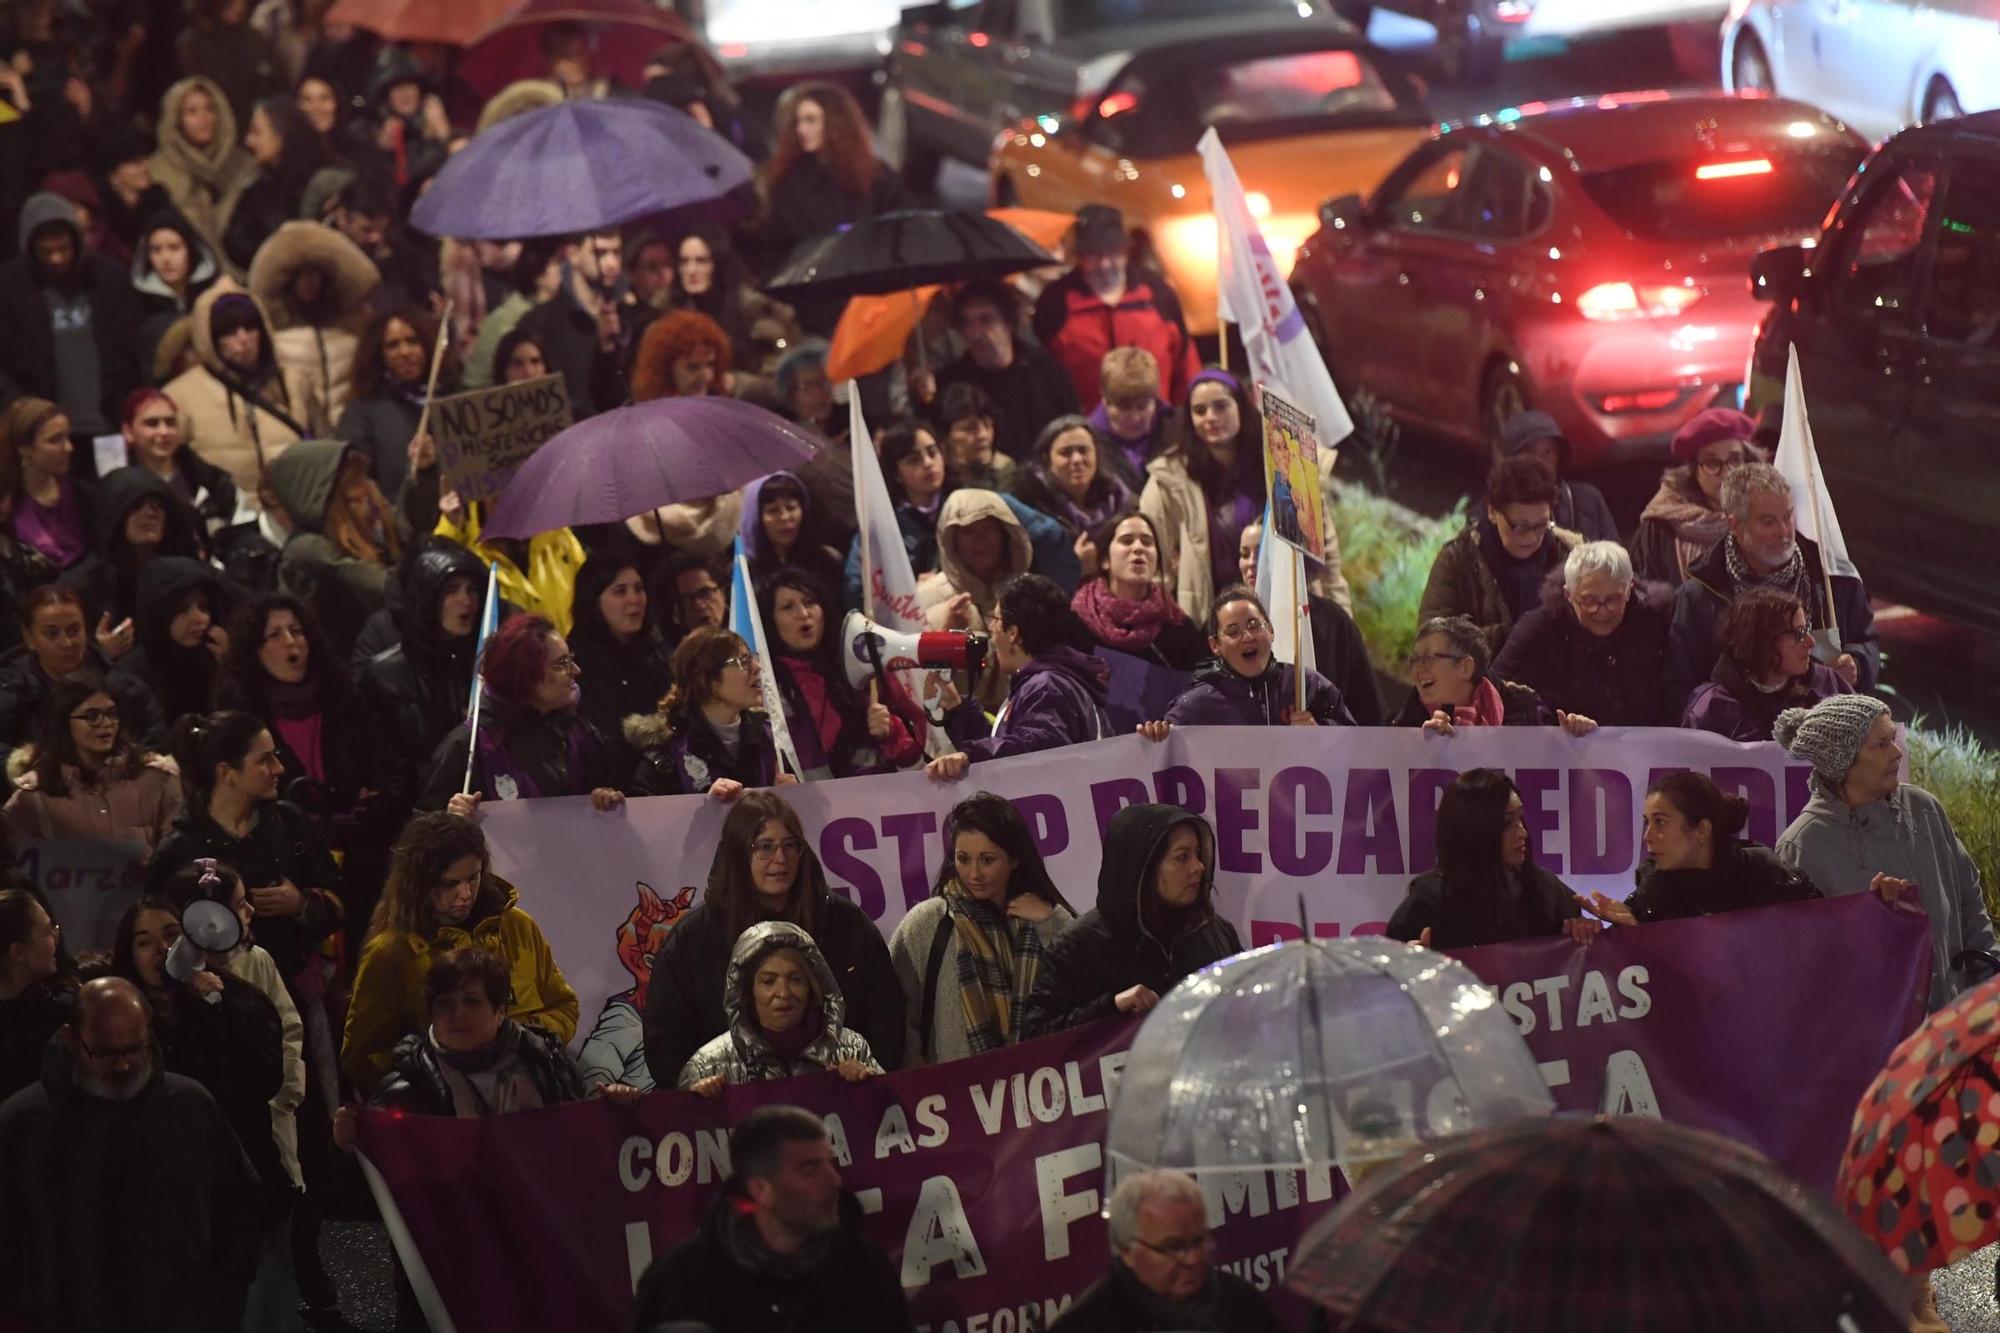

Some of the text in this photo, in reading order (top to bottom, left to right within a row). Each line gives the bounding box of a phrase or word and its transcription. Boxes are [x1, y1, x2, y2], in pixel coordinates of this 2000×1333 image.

[440, 382, 565, 437] NO SOMOS
[820, 793, 1070, 922] STP
[618, 1112, 853, 1192] CONA
[875, 1094, 951, 1160] AS
